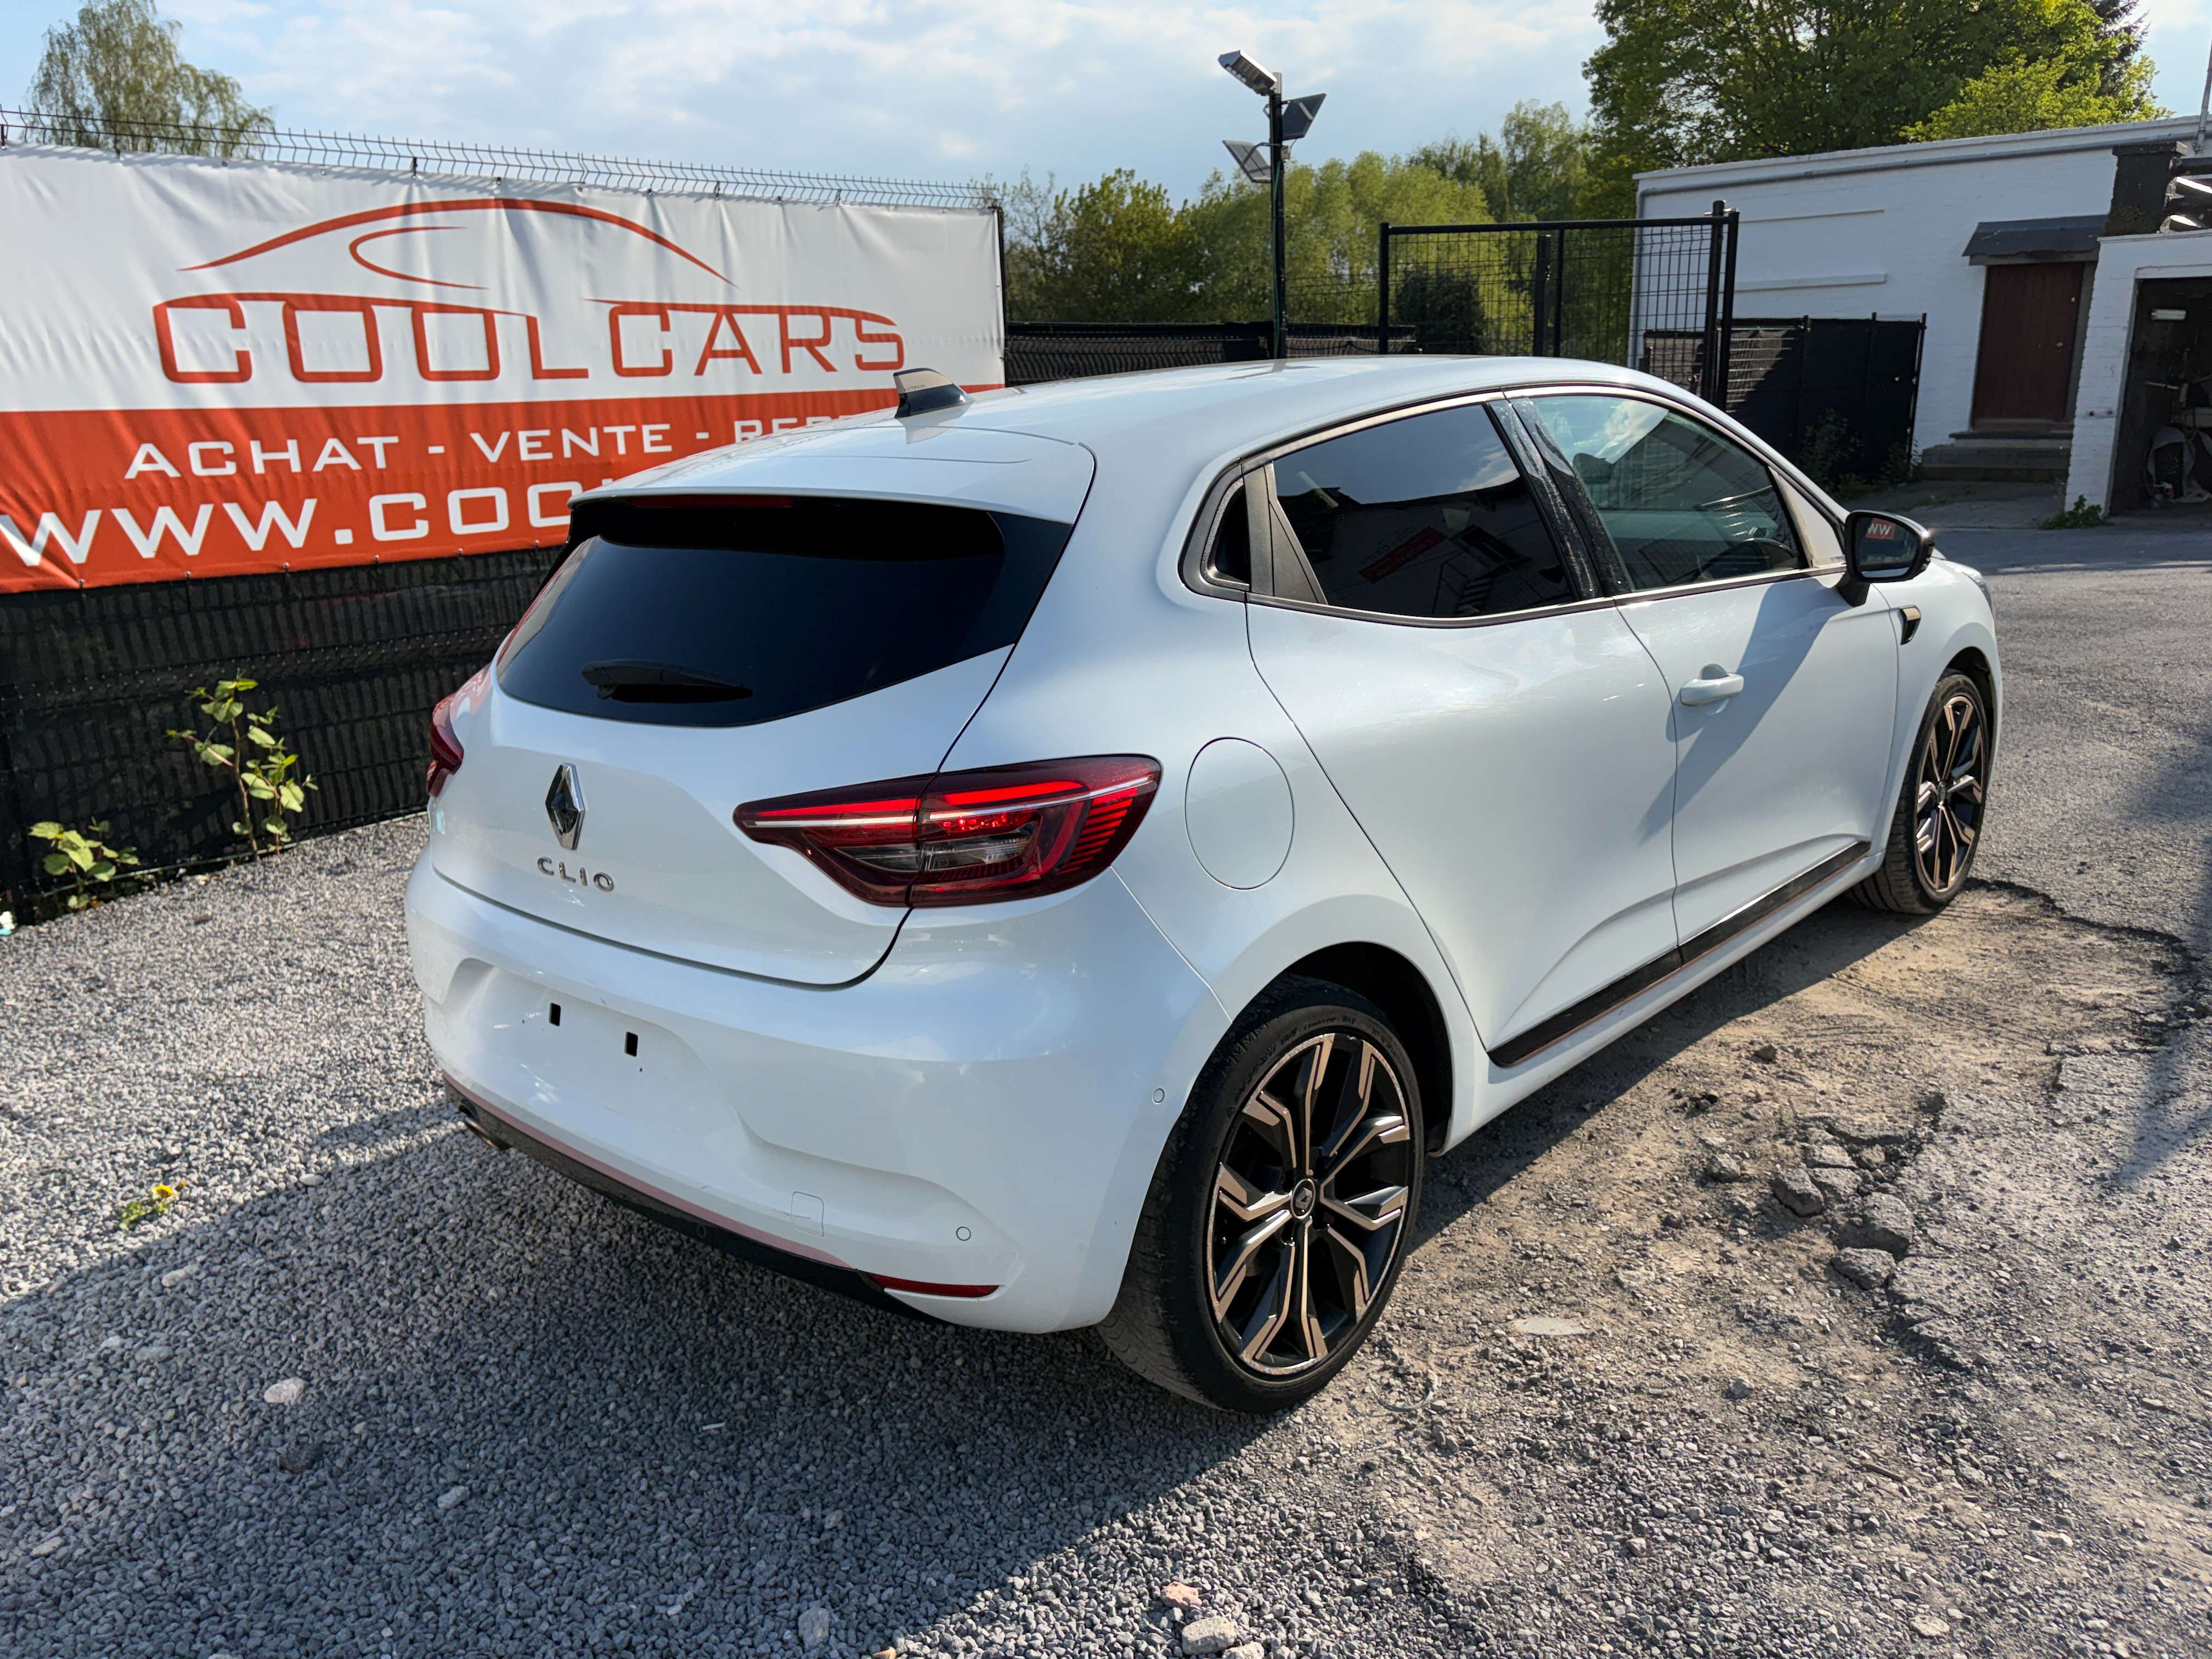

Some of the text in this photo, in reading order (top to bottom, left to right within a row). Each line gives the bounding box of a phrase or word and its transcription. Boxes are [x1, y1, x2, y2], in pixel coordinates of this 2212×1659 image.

[153, 292, 905, 383] COOL CARS
[124, 436, 399, 479] ACHAT
[470, 424, 672, 462] VENTE
[0, 478, 613, 566] WWW.COO
[537, 856, 614, 892] CLIO
